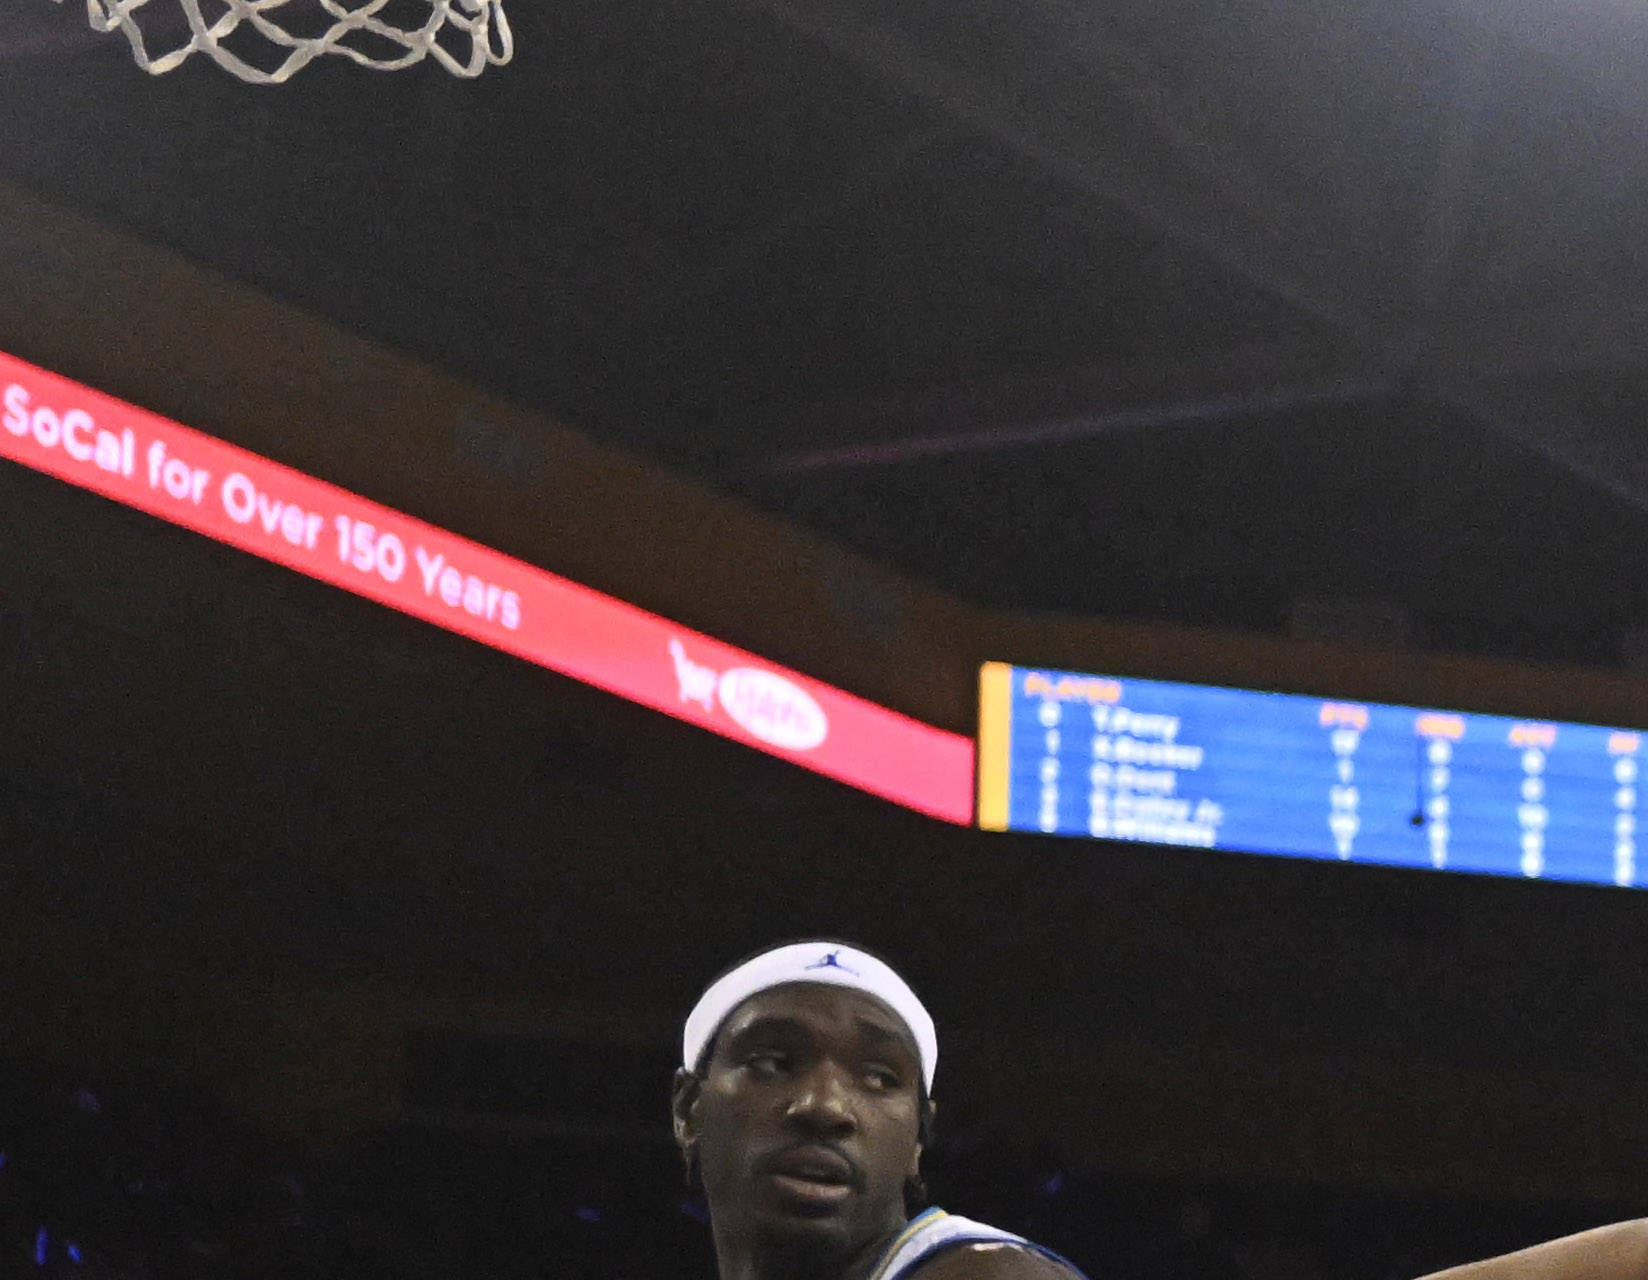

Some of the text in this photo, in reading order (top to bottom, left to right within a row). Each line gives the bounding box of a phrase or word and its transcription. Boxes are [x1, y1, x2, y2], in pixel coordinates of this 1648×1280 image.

[3, 383, 520, 630] SoCal for Over 150 Years
